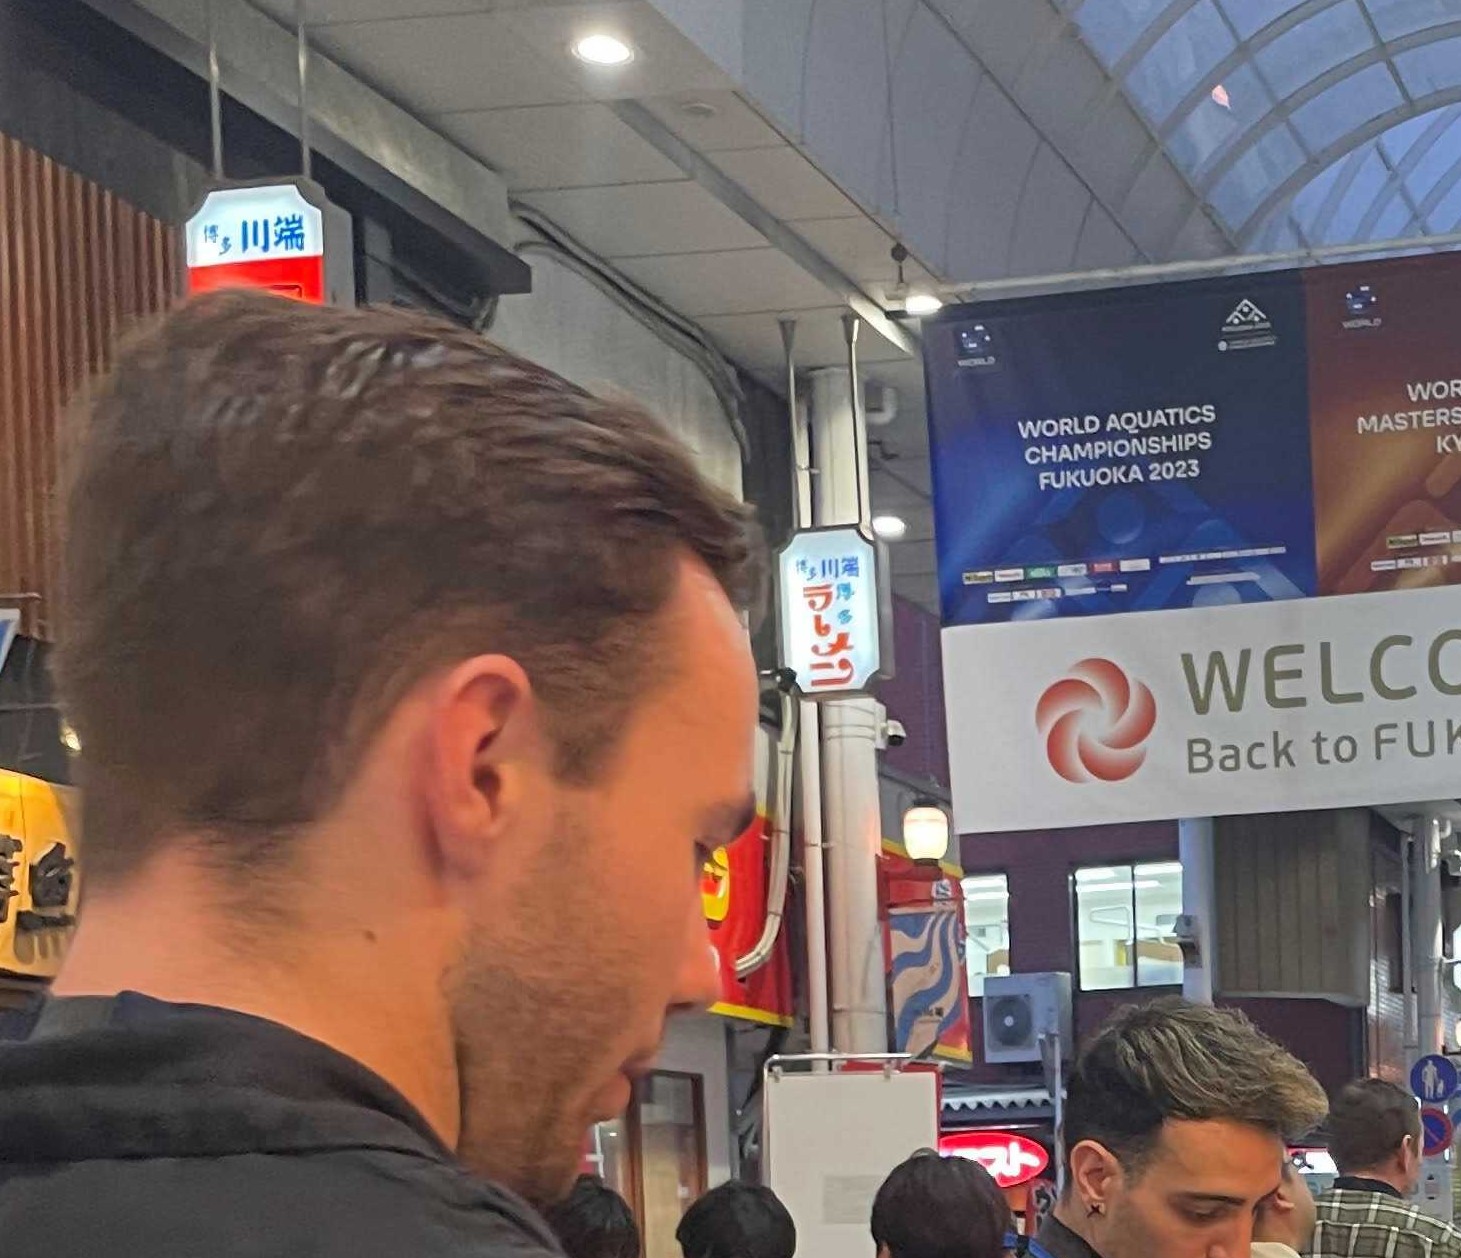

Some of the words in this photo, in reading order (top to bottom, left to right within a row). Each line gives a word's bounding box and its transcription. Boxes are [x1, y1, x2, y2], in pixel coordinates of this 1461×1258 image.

[204, 213, 305, 256] 博多川端
[1018, 415, 1100, 440] WORLD
[1106, 404, 1216, 433] AQUATICS
[1024, 432, 1212, 465] CHAMPIONSHIPS
[1039, 464, 1144, 490] FUKUOKA
[1149, 459, 1200, 481] 2023
[1187, 730, 1296, 774] Back
[1312, 731, 1358, 765] to
